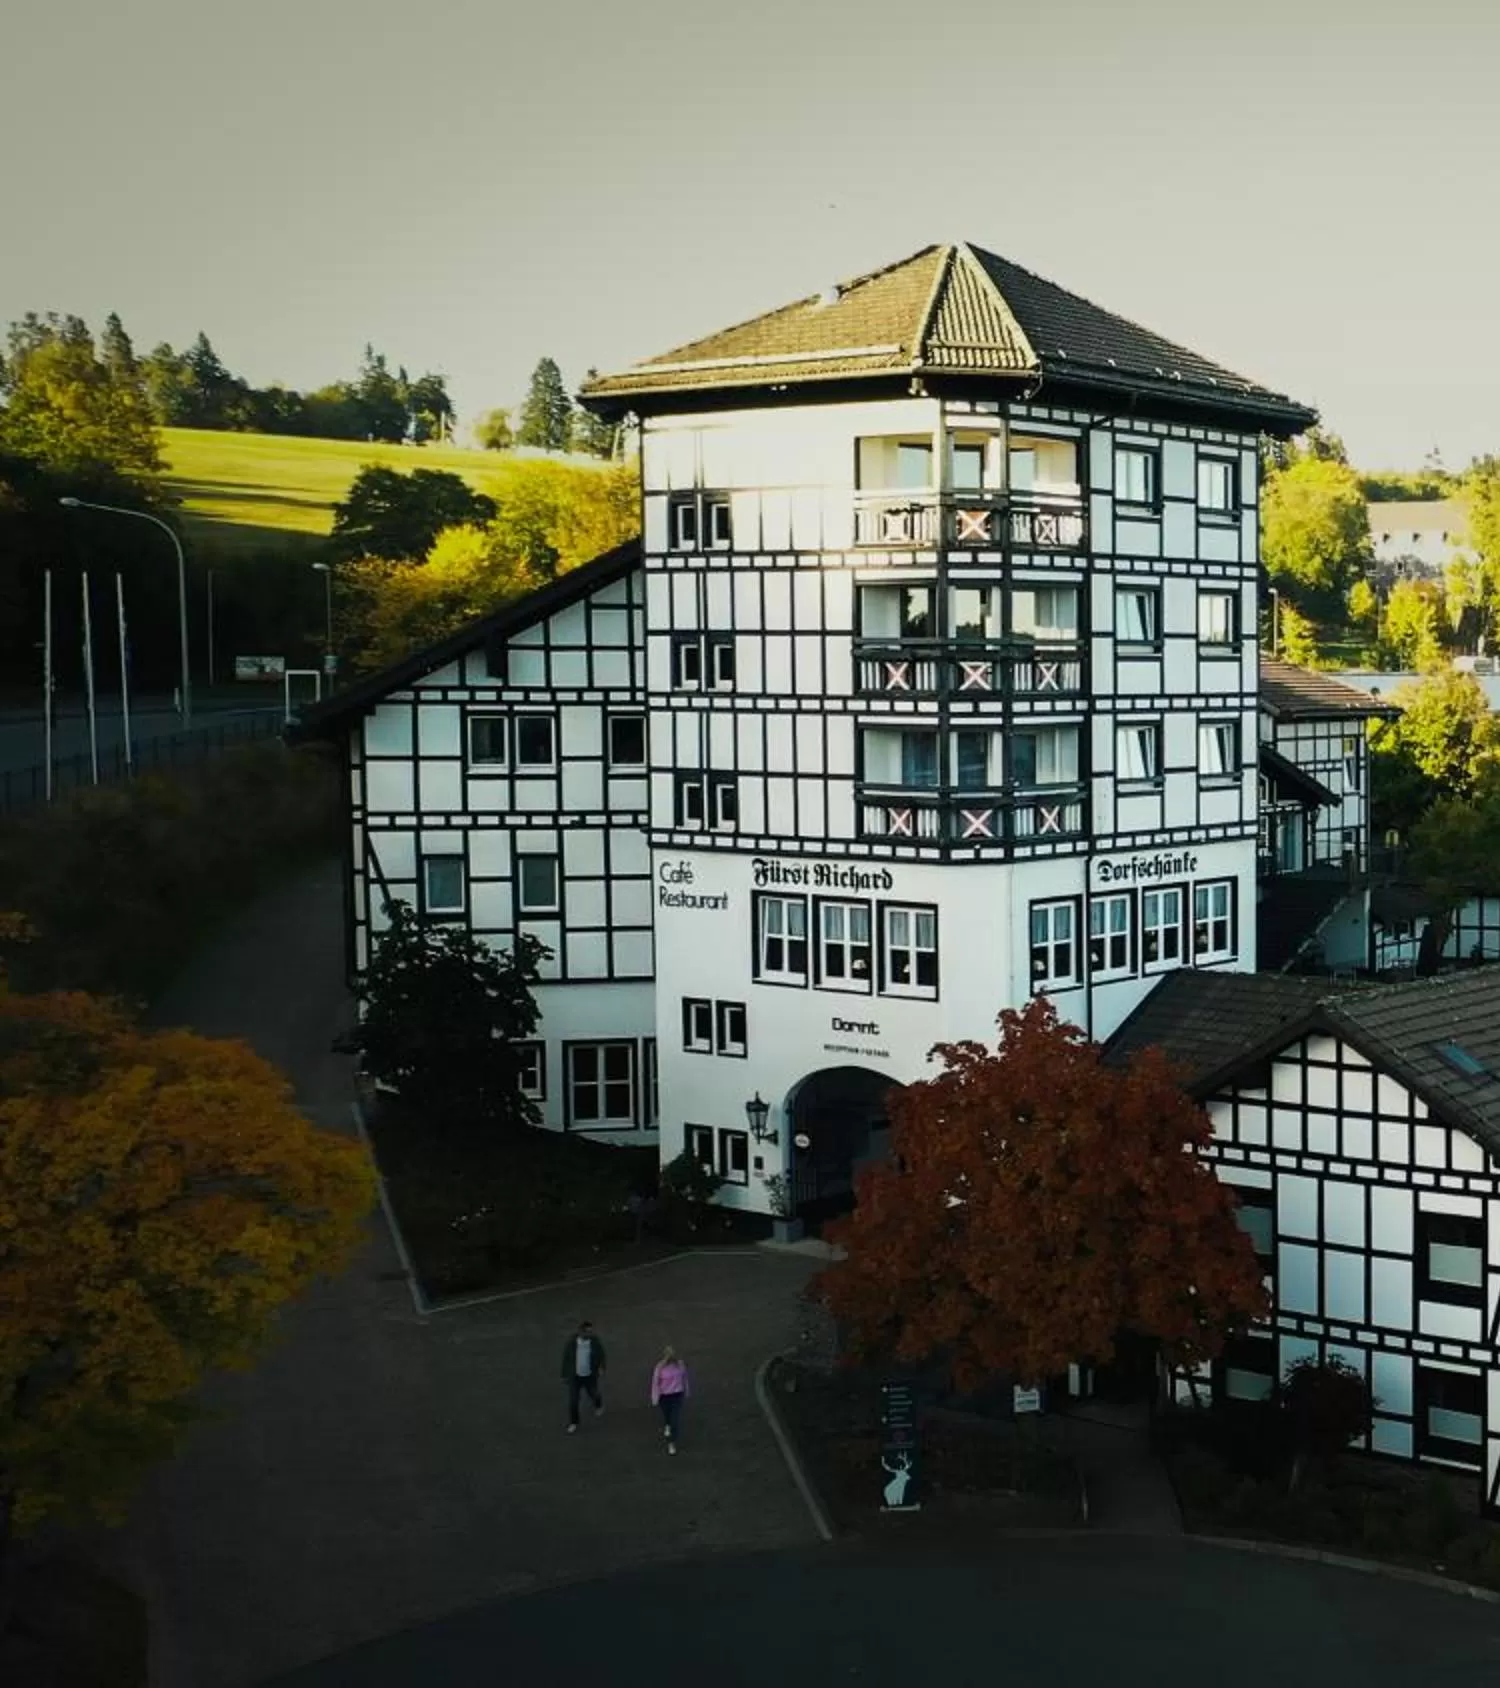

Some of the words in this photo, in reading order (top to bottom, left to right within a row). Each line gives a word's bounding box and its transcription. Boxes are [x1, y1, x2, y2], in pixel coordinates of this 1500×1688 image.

[659, 861, 694, 884] Café
[751, 857, 810, 887] Fürst
[813, 862, 893, 893] Richard
[1097, 851, 1198, 884] Dorfschänke
[659, 886, 729, 910] Restaurant
